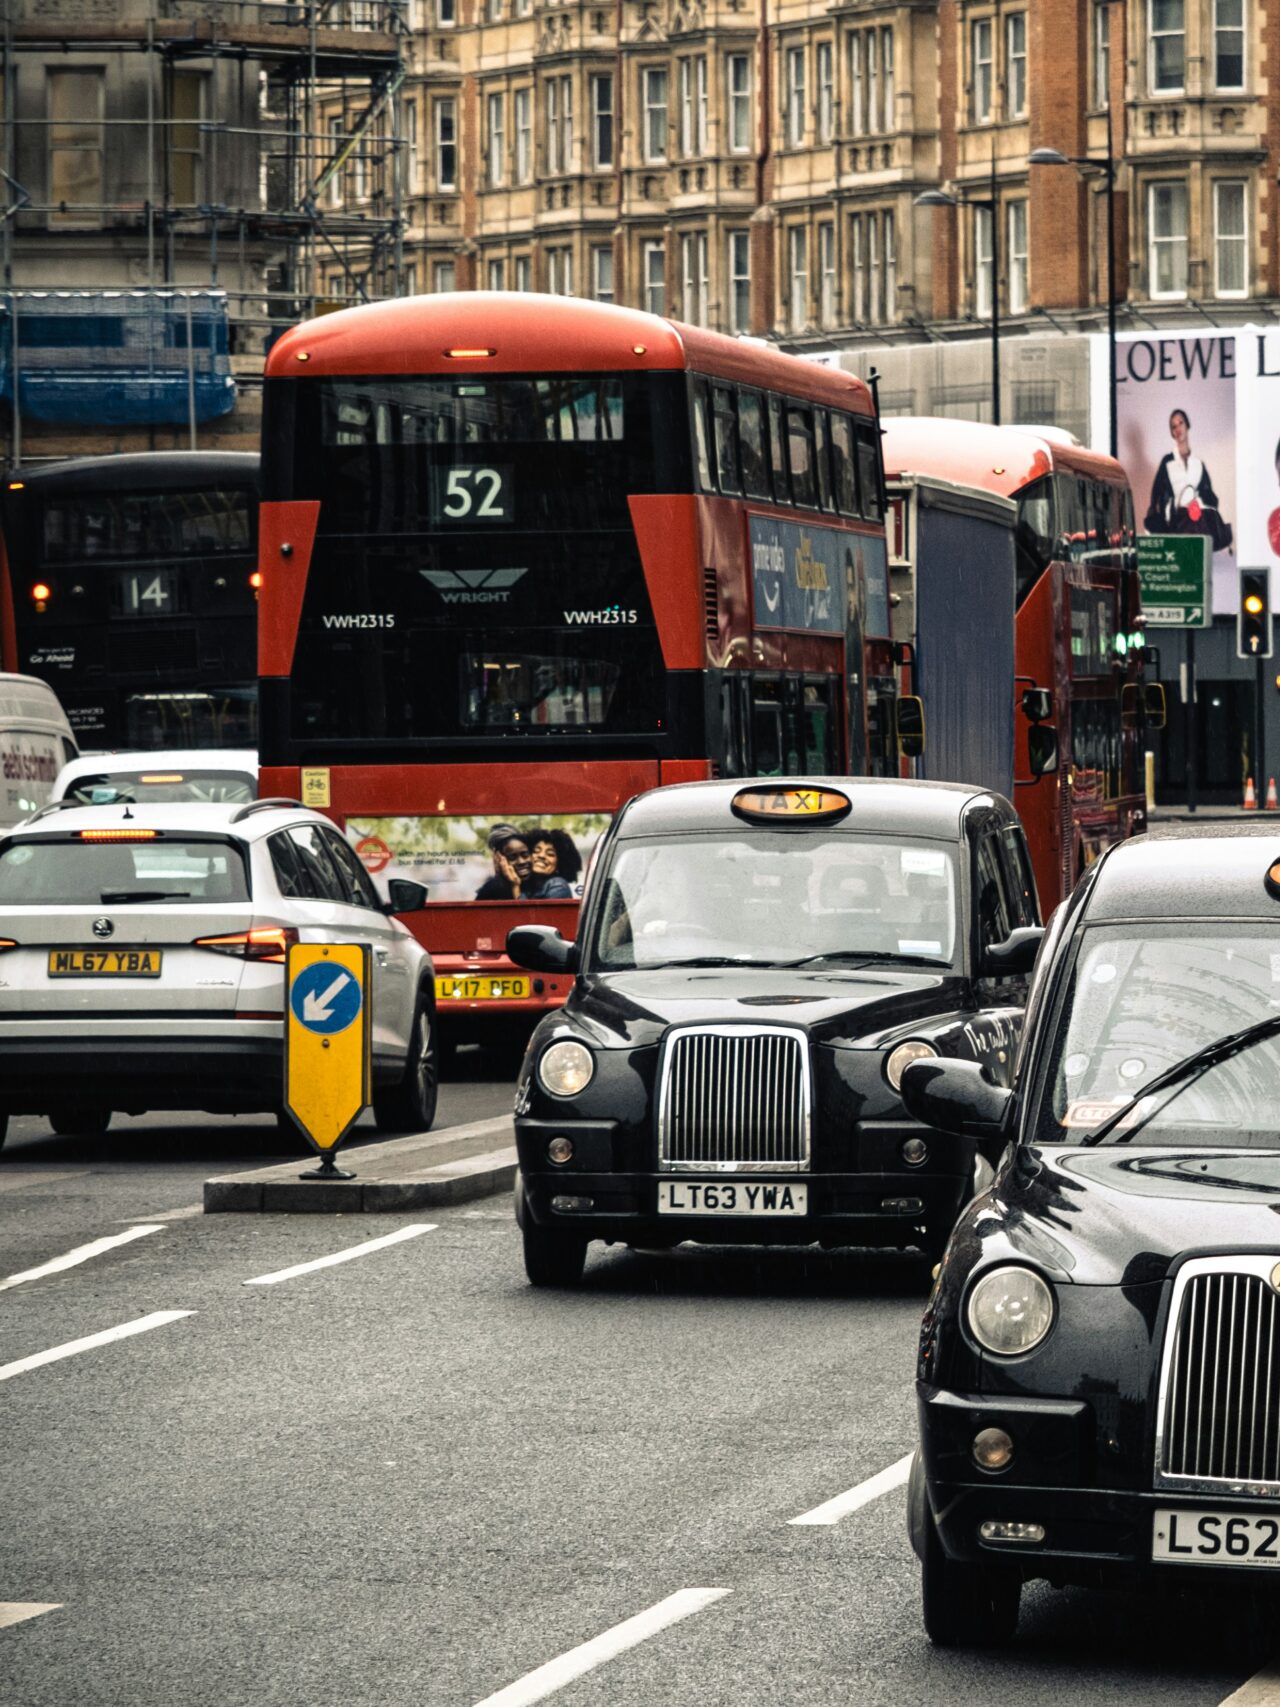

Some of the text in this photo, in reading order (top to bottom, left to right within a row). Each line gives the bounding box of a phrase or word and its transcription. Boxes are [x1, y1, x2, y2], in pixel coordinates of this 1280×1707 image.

[1116, 337, 1236, 382] OEWE
[443, 469, 504, 517] 52
[1139, 539, 1164, 547] WEST
[1145, 572, 1170, 582] Court
[132, 577, 168, 608] 14
[441, 592, 511, 604] WRIGHT
[323, 615, 394, 629] VWH2315
[564, 610, 637, 624] VWH2315
[759, 792, 823, 810] TAXI
[56, 952, 152, 971] ML67 YBA
[442, 981, 480, 996] LK17
[1081, 1109, 1112, 1118] LTD
[669, 1184, 795, 1210] LT63 YWA
[1168, 1514, 1279, 1557] LS62
